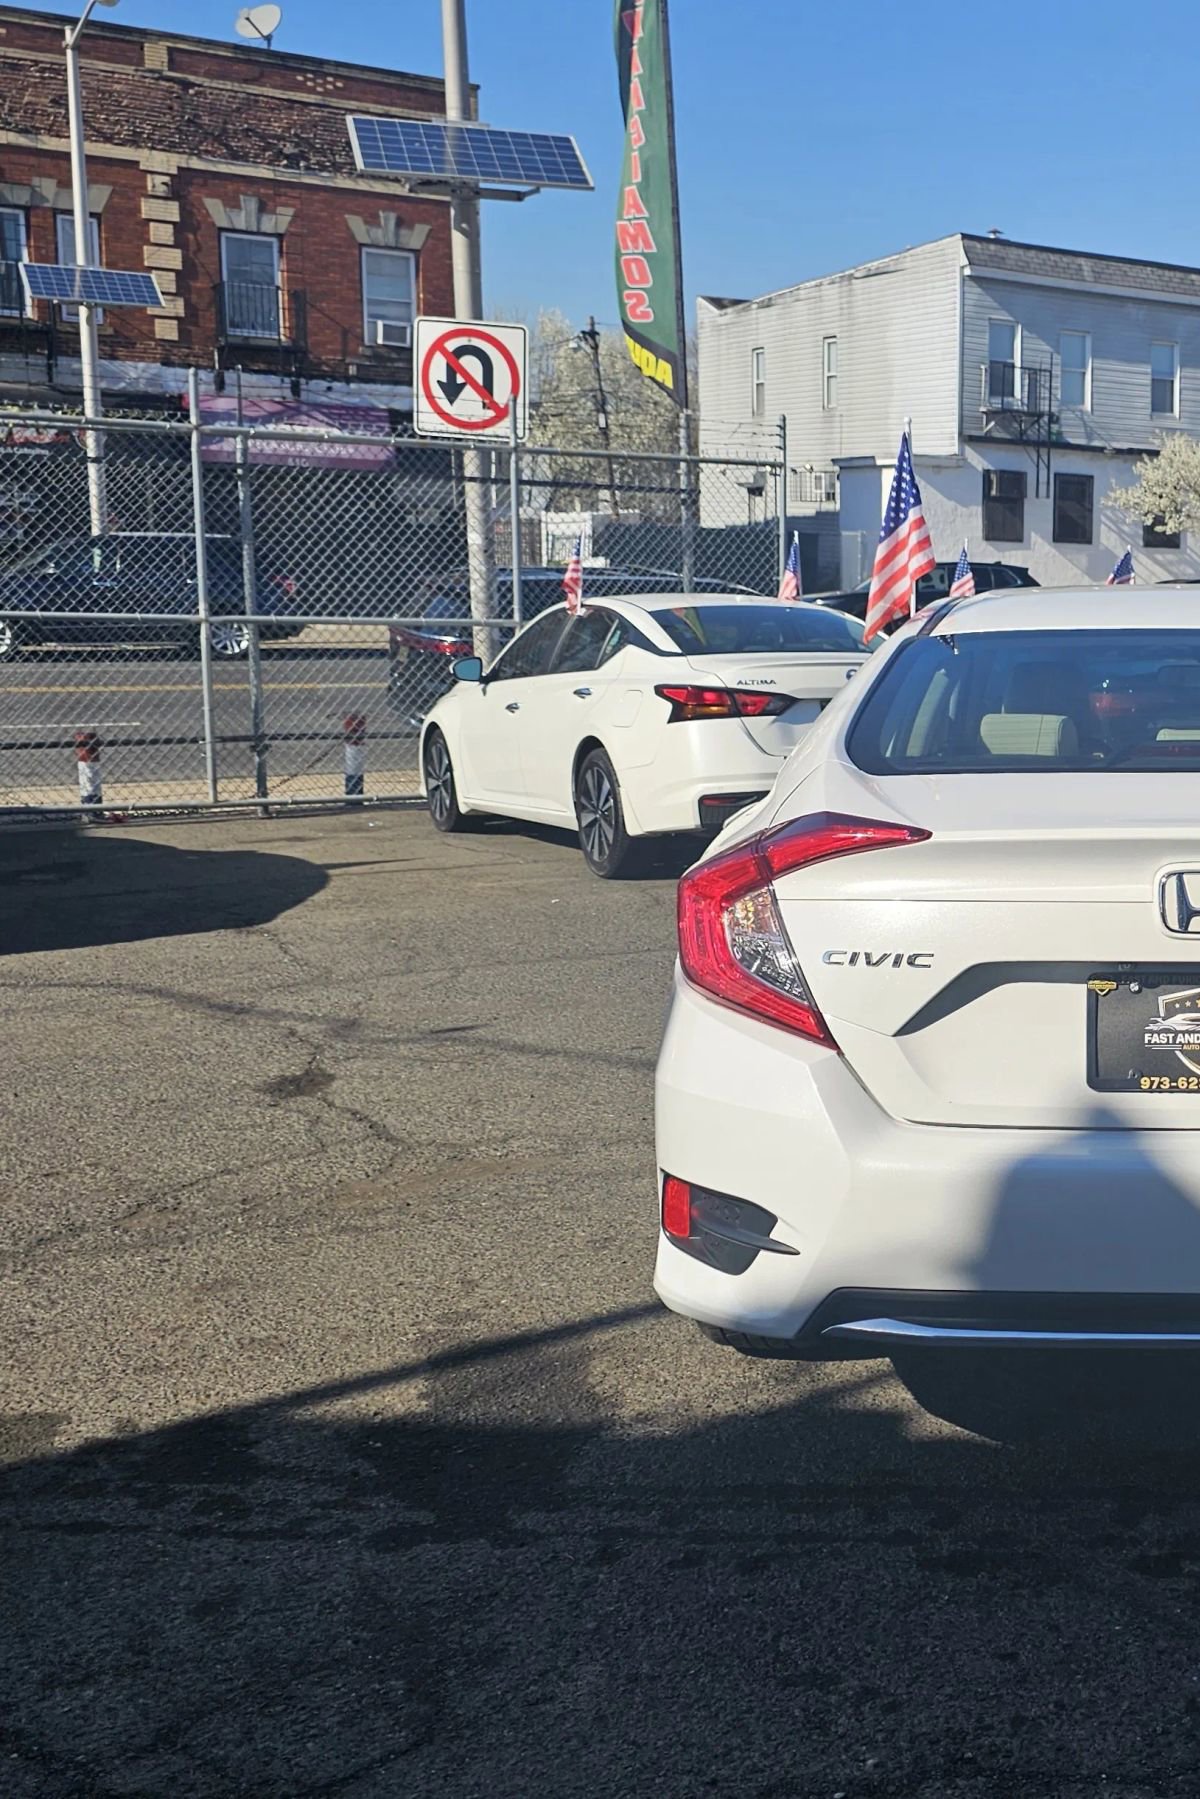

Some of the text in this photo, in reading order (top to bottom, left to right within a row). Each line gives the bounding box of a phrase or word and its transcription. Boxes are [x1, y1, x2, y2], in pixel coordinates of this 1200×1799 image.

[822, 950, 935, 969] CIVIC
[1148, 975, 1170, 985] AND
[1144, 1033, 1175, 1044] FAST
